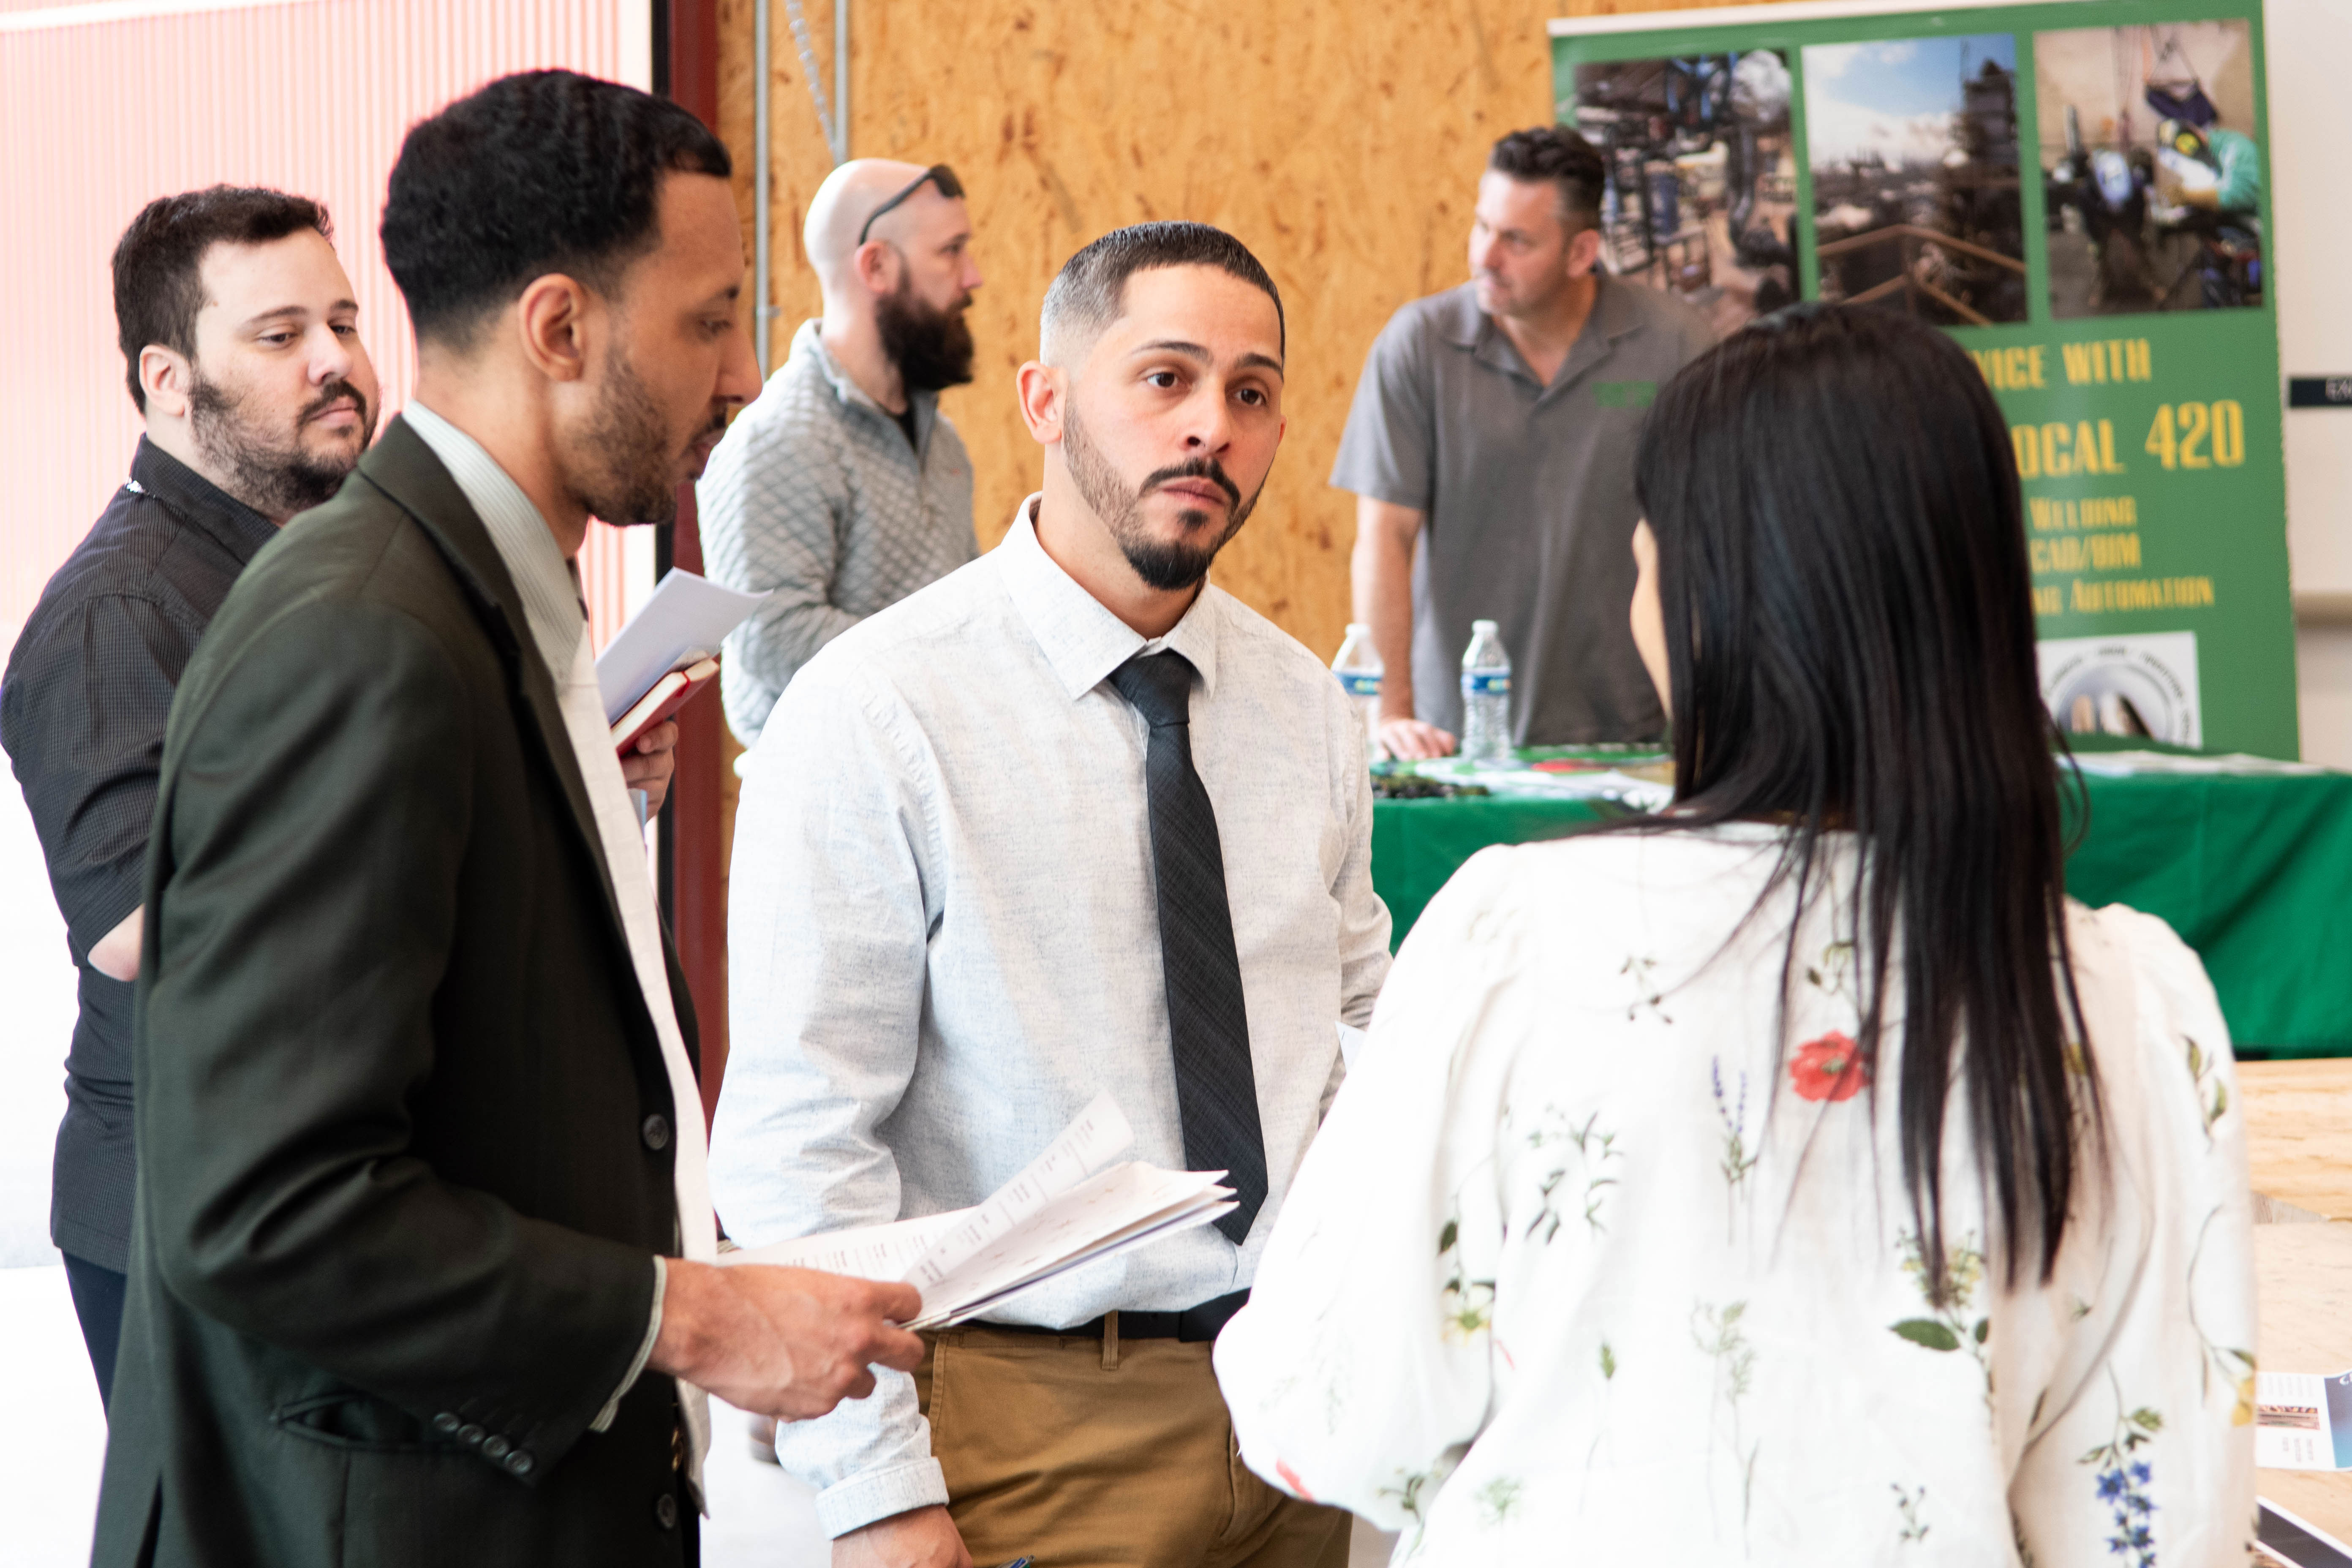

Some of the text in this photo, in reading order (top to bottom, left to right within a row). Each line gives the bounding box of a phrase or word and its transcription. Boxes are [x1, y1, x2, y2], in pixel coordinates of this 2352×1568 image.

[2061, 338, 2152, 385] WITH
[2011, 399, 2245, 481] OCAL 420
